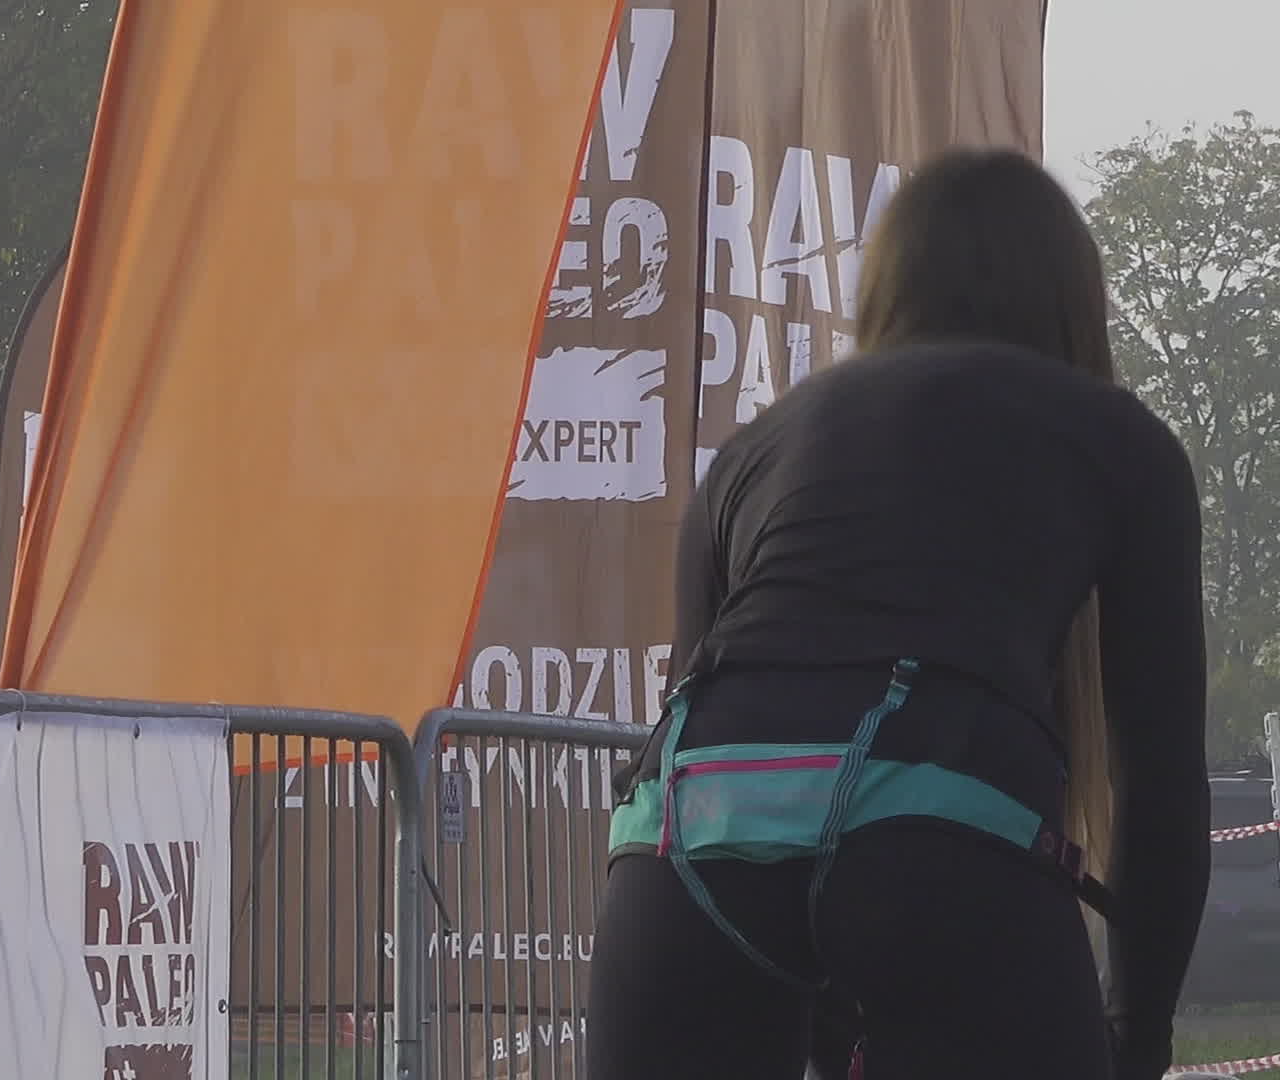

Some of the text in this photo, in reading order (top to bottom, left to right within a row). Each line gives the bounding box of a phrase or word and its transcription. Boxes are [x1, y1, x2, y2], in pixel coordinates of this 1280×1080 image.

[699, 308, 856, 424] PAL
[514, 420, 641, 464] XPERT
[452, 645, 673, 728] ODZIE
[81, 840, 199, 946] RAW
[84, 953, 196, 1028] PALEO
